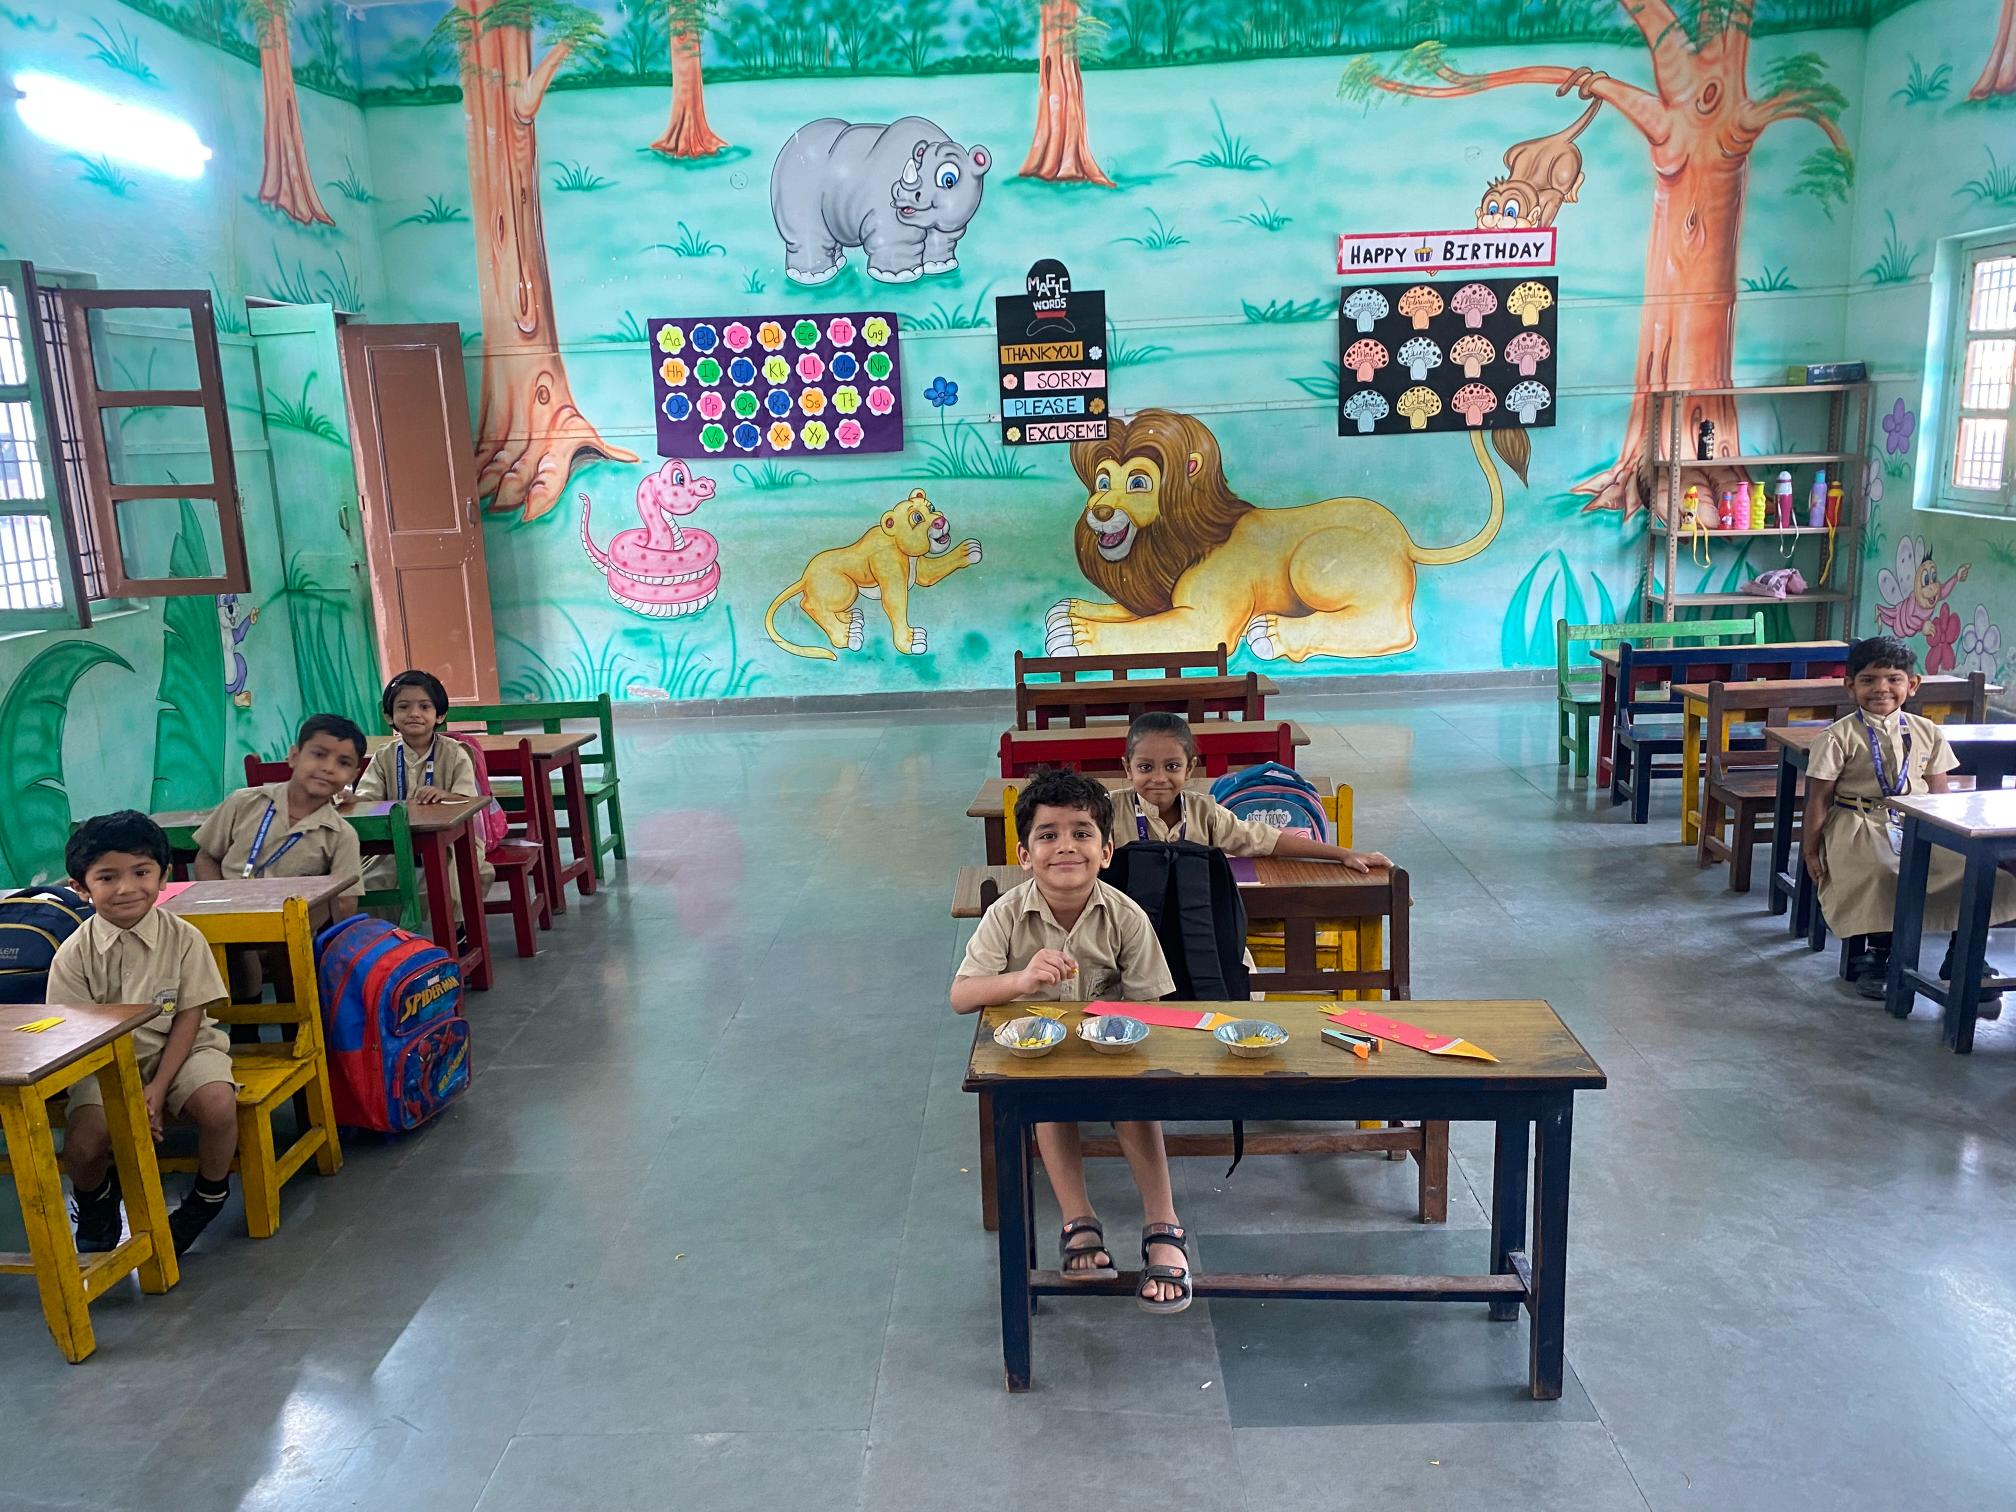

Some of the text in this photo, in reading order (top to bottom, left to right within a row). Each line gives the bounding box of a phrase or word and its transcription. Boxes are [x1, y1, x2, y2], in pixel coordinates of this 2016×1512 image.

[1350, 240, 1545, 265] HAPPY BIRTHDAY
[1028, 274, 1069, 298] MAGIC
[1033, 298, 1066, 310] WORDS
[1405, 296, 1435, 307] February
[1460, 294, 1488, 305] March
[1517, 289, 1538, 303] April
[663, 323, 883, 346] Aa Bb Cc Dd Ee Ff Gg
[1356, 349, 1375, 359] May
[1408, 345, 1430, 357] June
[666, 364, 683, 377] Hh
[769, 362, 785, 377] Kk
[804, 360, 816, 375] Ll
[836, 360, 854, 373] Mm
[870, 358, 886, 372] Nn
[1037, 372, 1092, 388] SORRY
[670, 399, 686, 414] Oo
[705, 397, 717, 416] Pp
[737, 398, 754, 412] Qq
[805, 394, 821, 409] Ss
[839, 392, 854, 408] Tt
[873, 392, 889, 407] Uu
[1015, 398, 1077, 415] PLEASE
[705, 430, 721, 444] Vv
[774, 427, 790, 442] Xx
[808, 427, 821, 444] Yy
[841, 426, 859, 440] Zz
